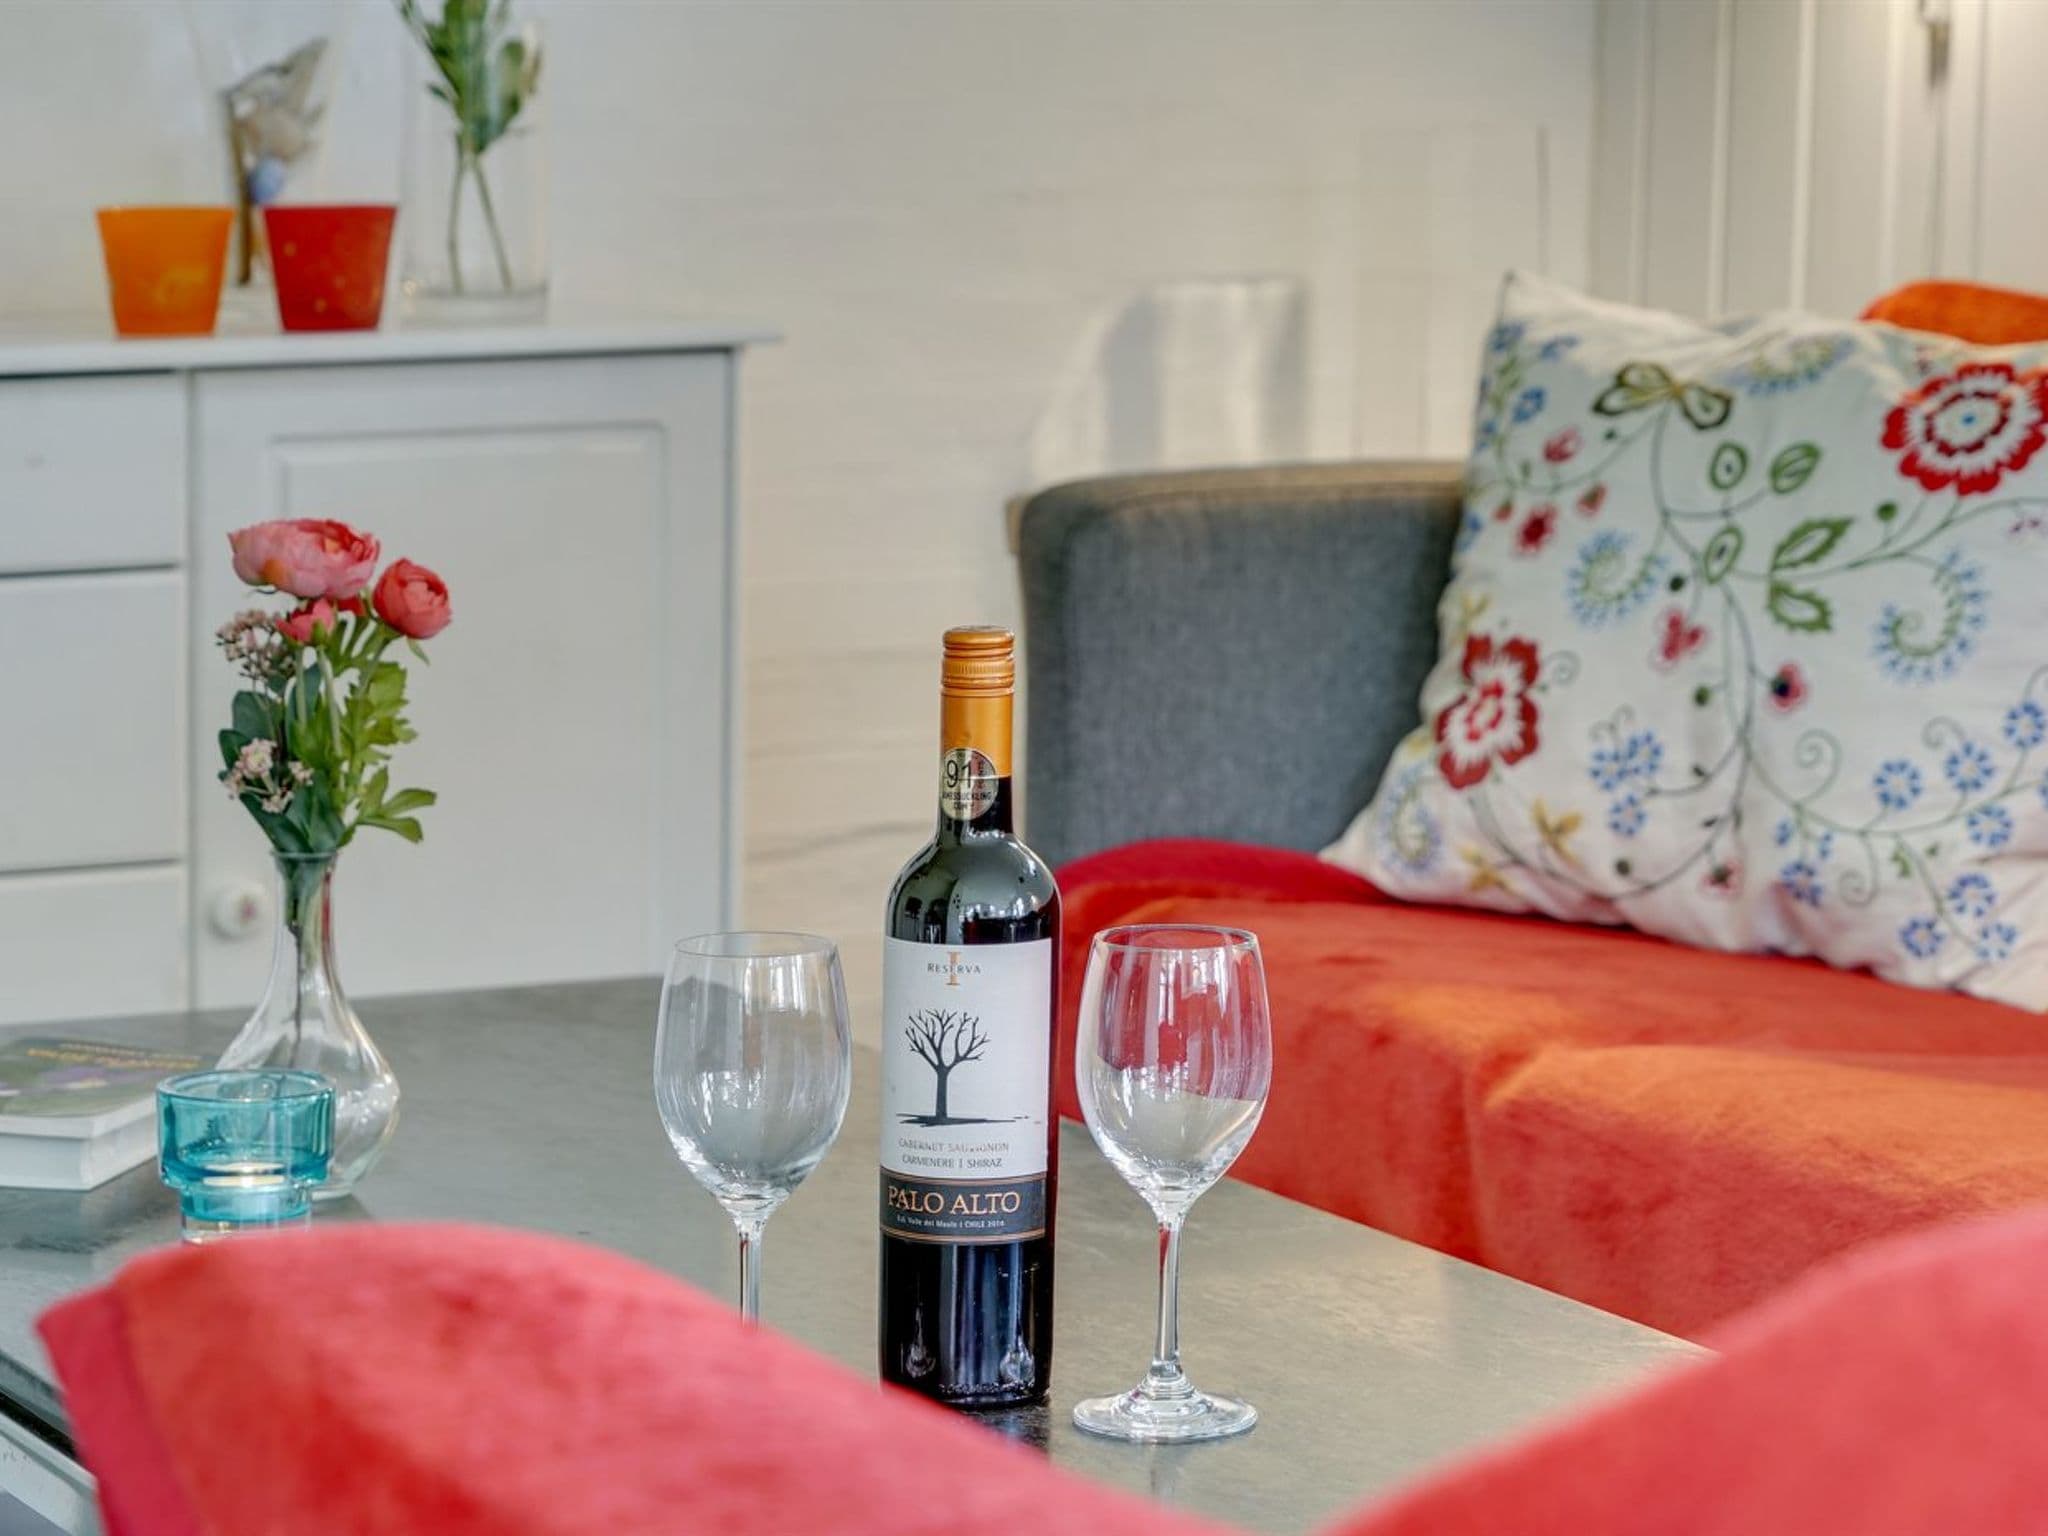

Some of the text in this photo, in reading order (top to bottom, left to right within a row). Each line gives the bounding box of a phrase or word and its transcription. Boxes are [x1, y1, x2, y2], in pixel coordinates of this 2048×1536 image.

[947, 760, 972, 788] 91
[948, 1142, 1009, 1153] SAUGNON
[967, 1157, 1003, 1169] SHIRAZ
[888, 1185, 1021, 1215] PALO ALTO
